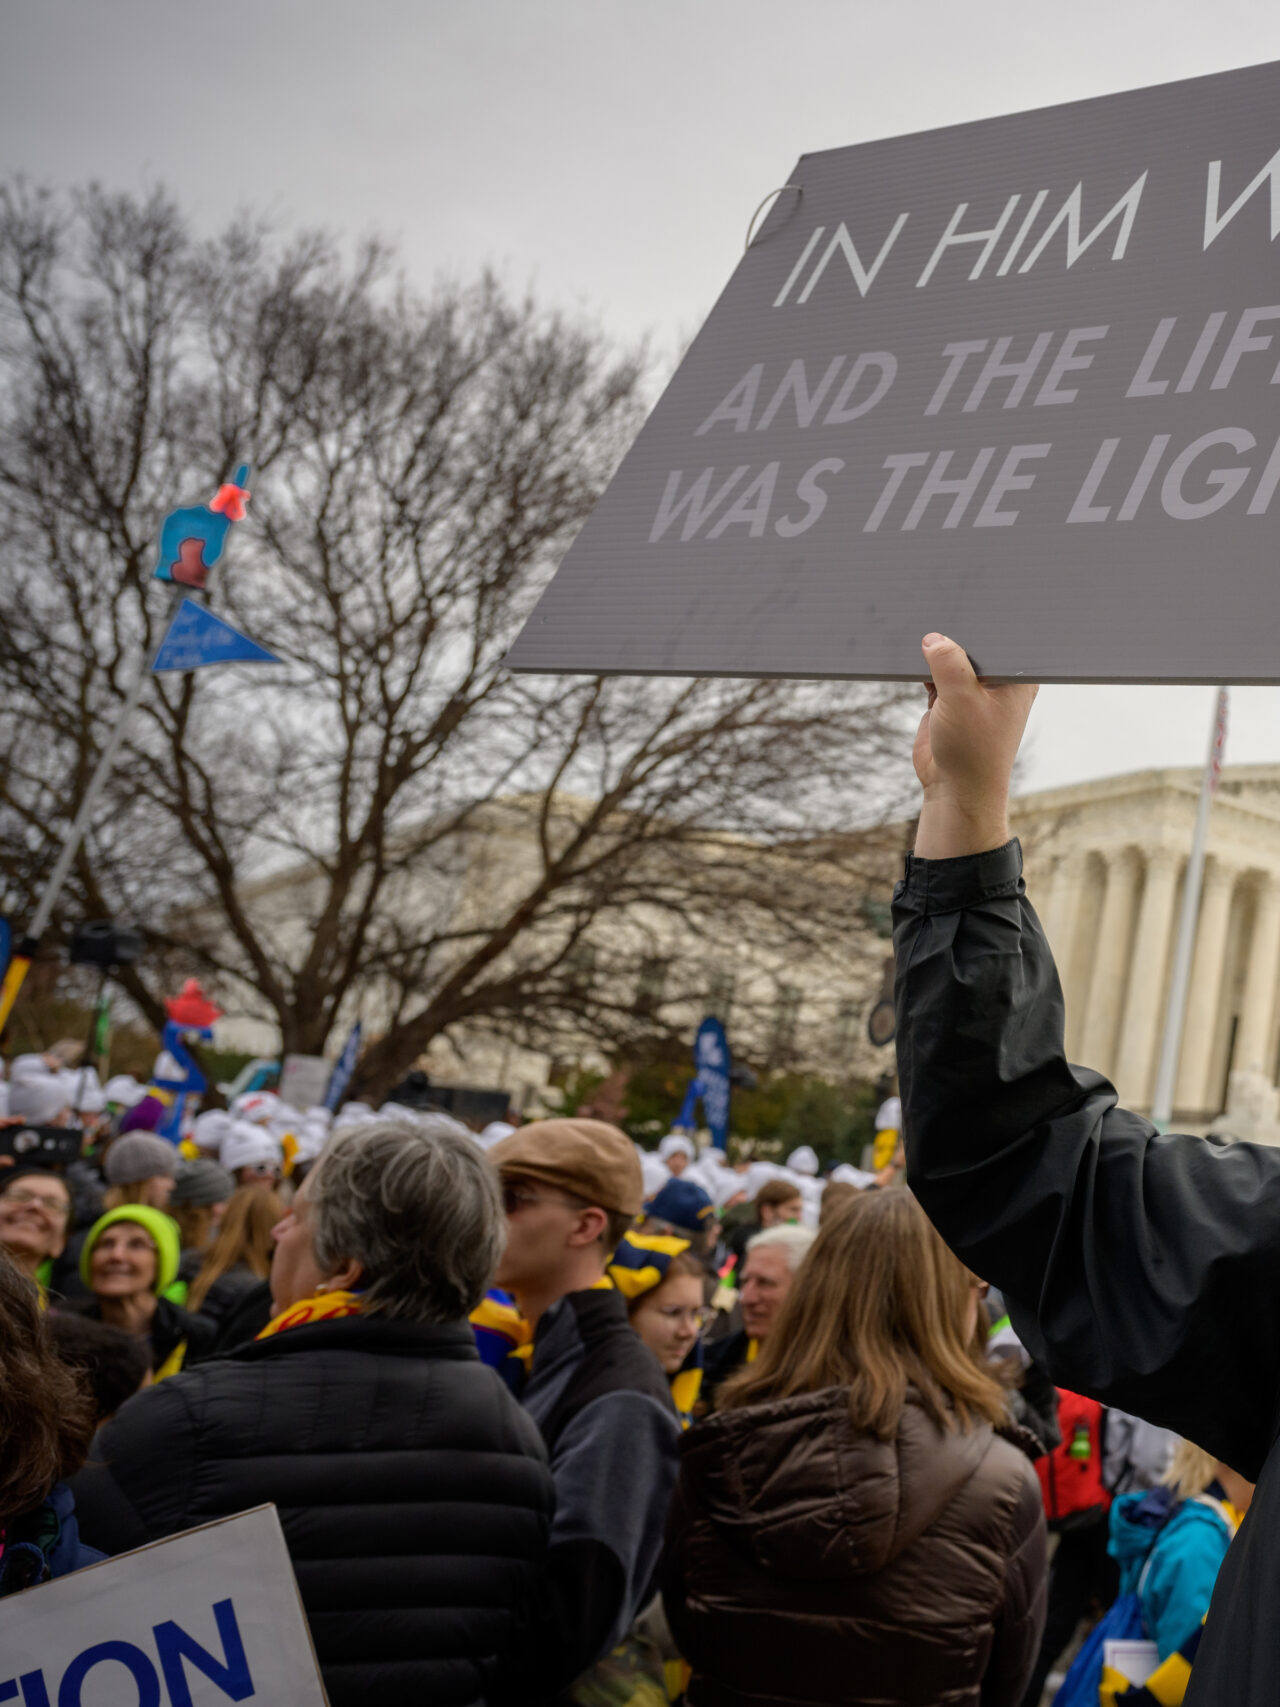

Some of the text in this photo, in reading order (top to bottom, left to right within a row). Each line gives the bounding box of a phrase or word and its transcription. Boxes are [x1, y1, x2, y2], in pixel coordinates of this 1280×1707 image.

[772, 213, 909, 308] IN
[916, 168, 1149, 288] HIM
[693, 350, 898, 436] AND
[923, 325, 1109, 416] THE
[648, 456, 844, 543] WAS
[862, 442, 1051, 532] THE
[0, 1597, 256, 1707] ON
